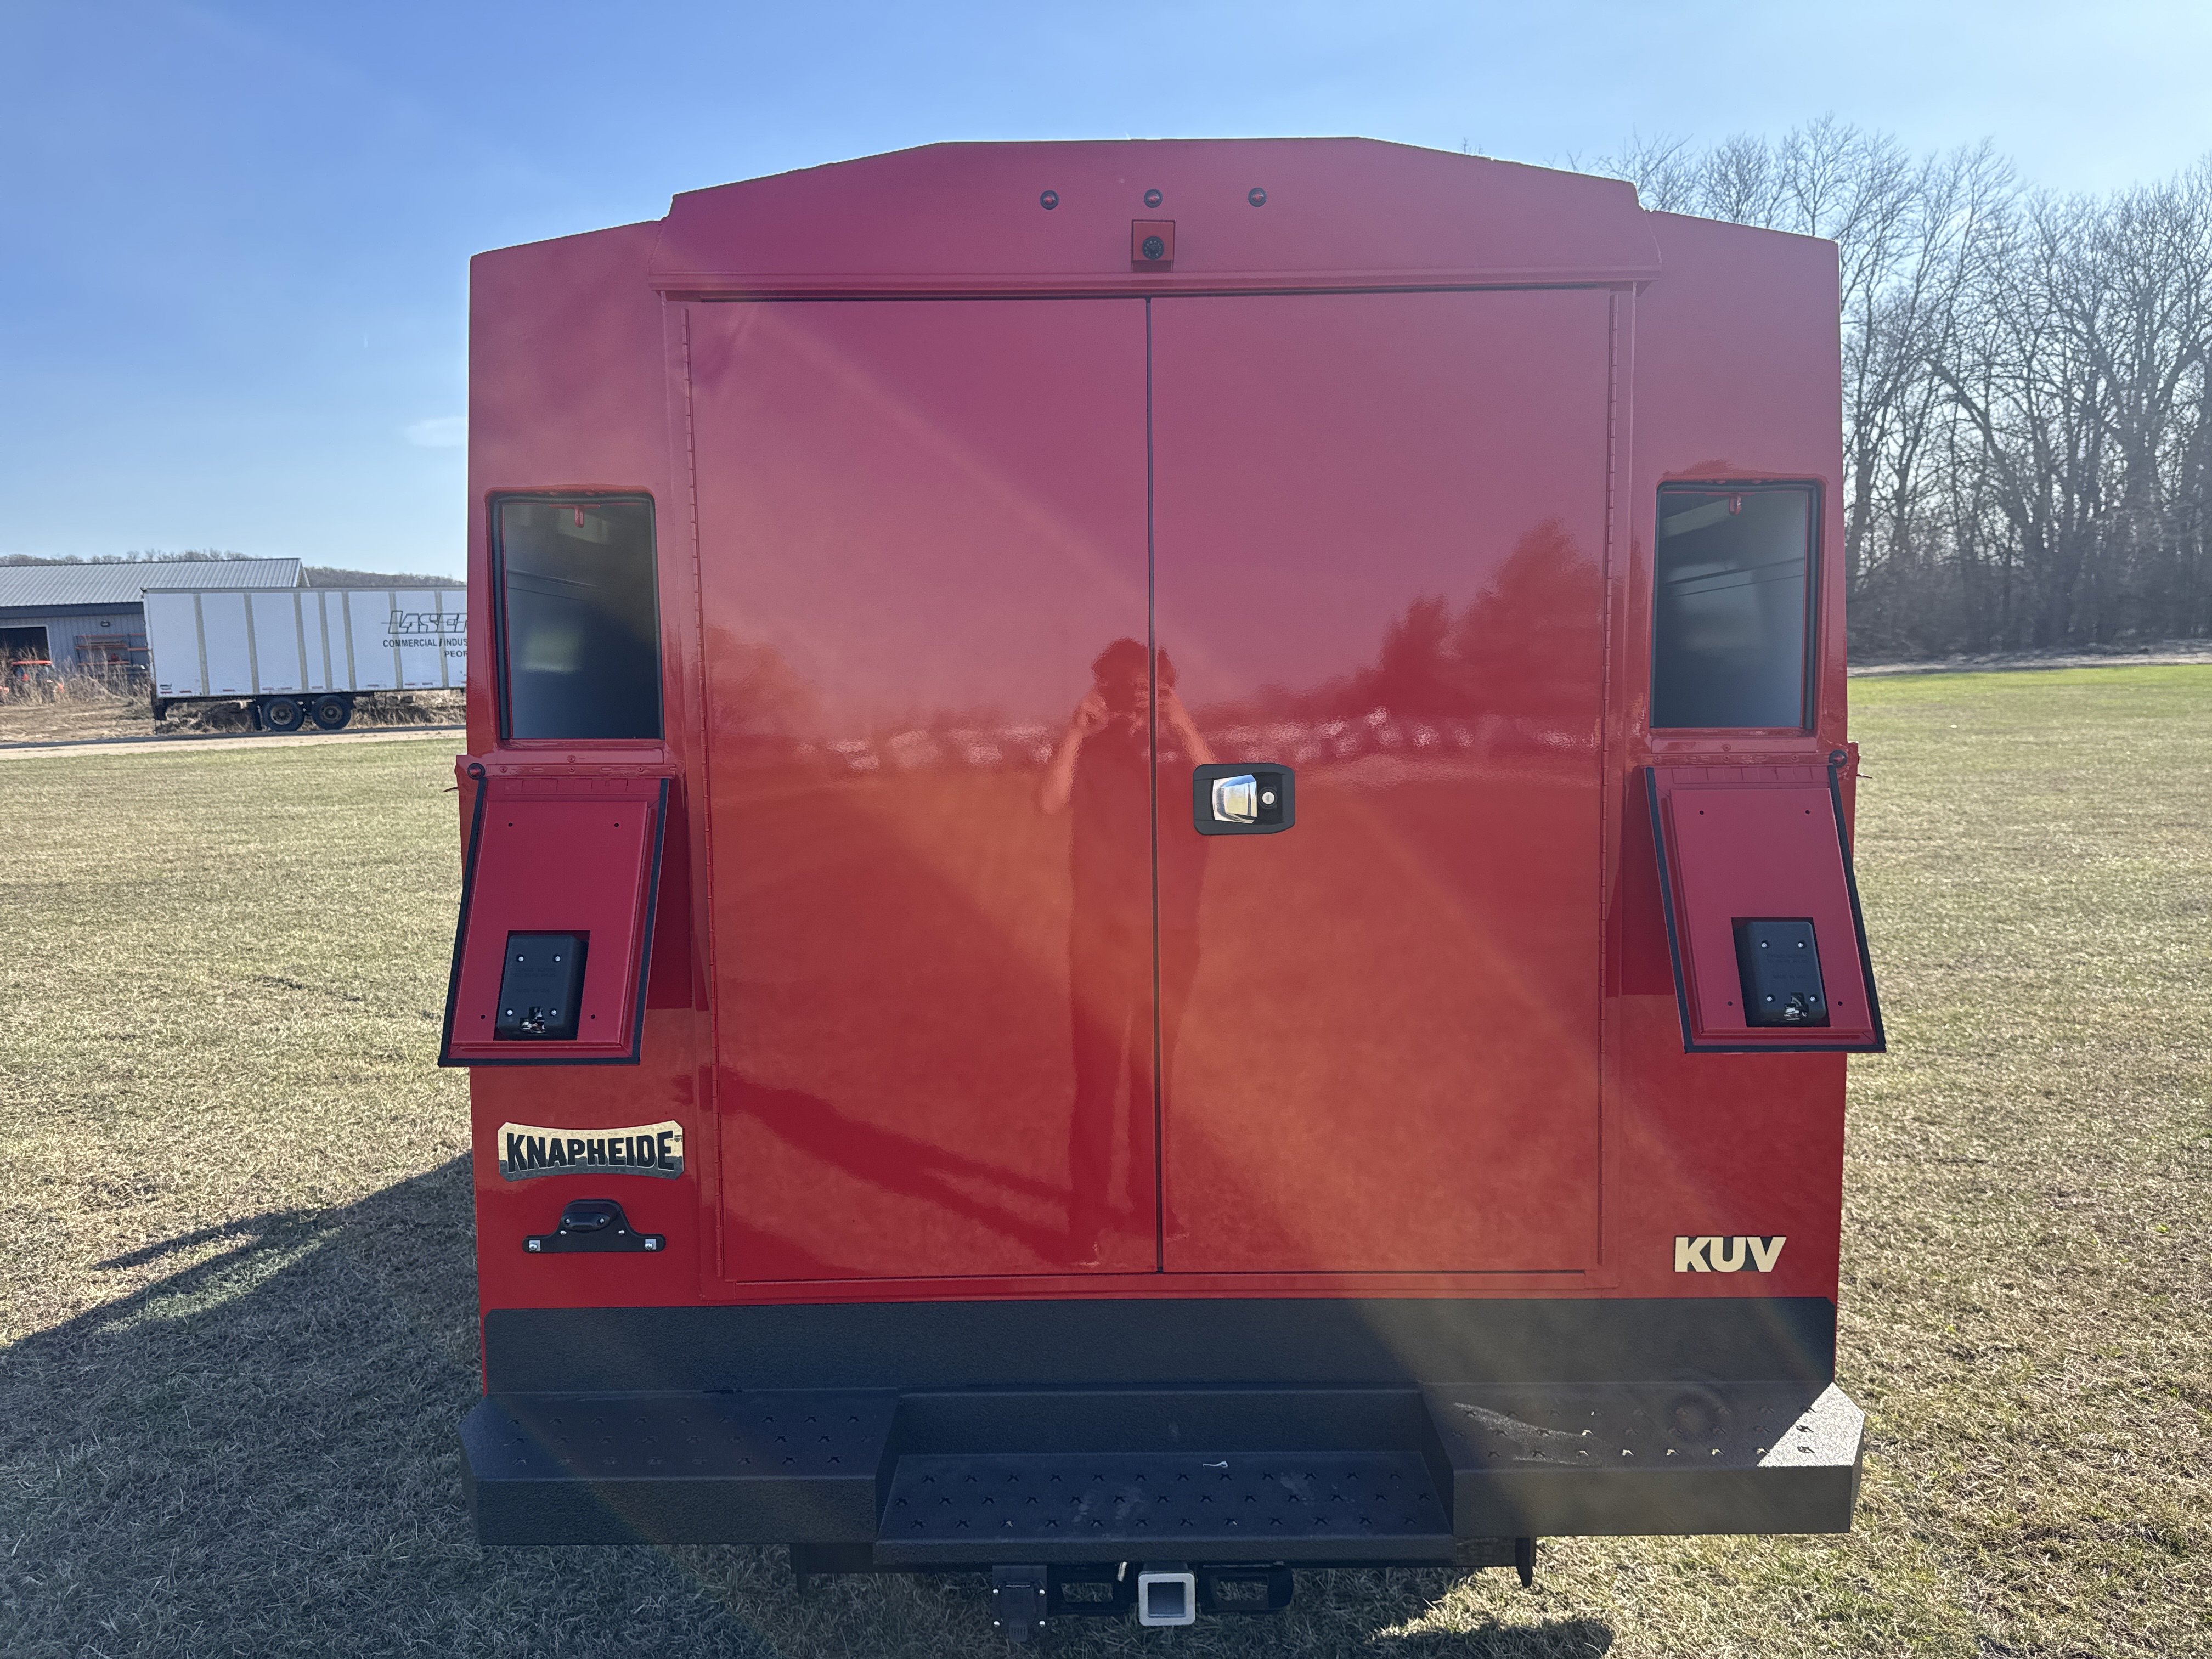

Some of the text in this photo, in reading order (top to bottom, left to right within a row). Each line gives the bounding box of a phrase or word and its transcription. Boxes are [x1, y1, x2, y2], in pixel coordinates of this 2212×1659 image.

[383, 638, 437, 648] COMMERCIAL
[506, 1130, 674, 1173] KNAPHEIDE
[1674, 1237, 1787, 1273] KUV
